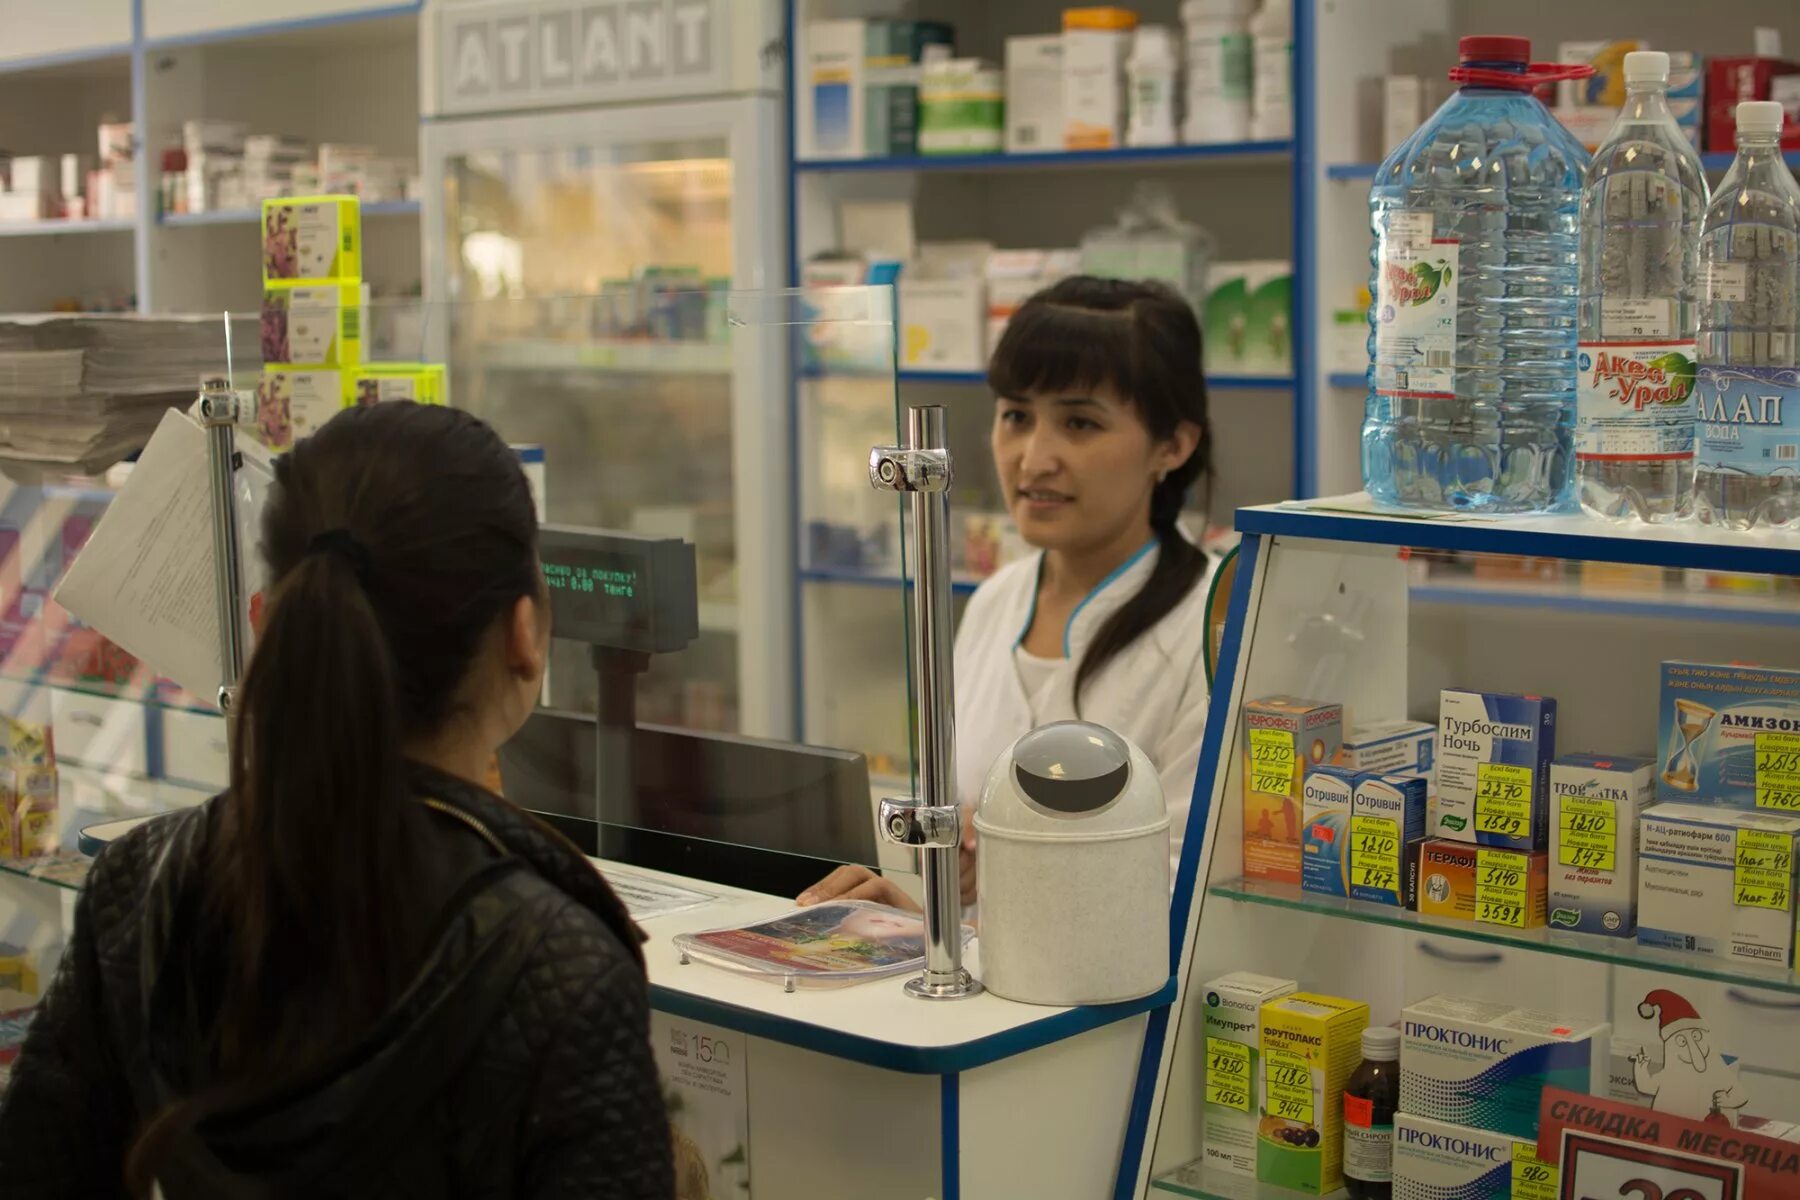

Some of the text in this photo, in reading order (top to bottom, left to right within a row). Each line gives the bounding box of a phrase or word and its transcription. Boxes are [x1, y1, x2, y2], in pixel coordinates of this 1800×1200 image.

[458, 10, 706, 87] ATLANT
[1593, 351, 1667, 389] Аква
[1696, 391, 1783, 424] АЛАП
[1706, 425, 1740, 440] ВОДА
[1248, 713, 1298, 730] НУРОФЕН
[1444, 716, 1531, 740] Турбослим
[1544, 712, 1552, 726] 30
[1443, 734, 1480, 752] Ночь
[1256, 745, 1290, 761] 1550
[1758, 753, 1800, 772] 2515
[1306, 786, 1348, 804] Отривин
[1482, 781, 1522, 800] 2270
[1554, 782, 1629, 801] ТРОЙАТКА
[1762, 788, 1800, 808] 1760
[1356, 794, 1401, 812] Отривин
[1484, 815, 1520, 834] 1589
[1570, 814, 1606, 832] 1210
[1361, 836, 1394, 854] 1210
[1715, 832, 1731, 843] 600
[1427, 850, 1476, 868] ТЕРАФЛ
[1571, 848, 1606, 867] 847
[1364, 868, 1395, 888] 847
[1408, 862, 1416, 894] КАПСУЛ
[1484, 866, 1518, 886] 5140
[1577, 875, 1612, 885] паразитов
[1770, 889, 1786, 906] 34
[1482, 904, 1521, 924] 3598
[1685, 936, 1696, 950] 50
[1733, 945, 1782, 958] ratiopharm
[1222, 998, 1254, 1012] Bionorica
[1264, 1027, 1322, 1046] ФРУТОЛАКС
[1212, 1055, 1244, 1073] 1950
[1274, 1068, 1308, 1086] 1180
[1608, 1074, 1635, 1086] ЭКСИ
[1216, 1089, 1244, 1104] 1560
[1278, 1100, 1303, 1119] 944
[1360, 1131, 1392, 1140] СИРОП
[1551, 1100, 1800, 1174] СКИДКА МЕСЯЦА
[1206, 1148, 1232, 1160] 100 мл
[1522, 1166, 1550, 1181] 980
